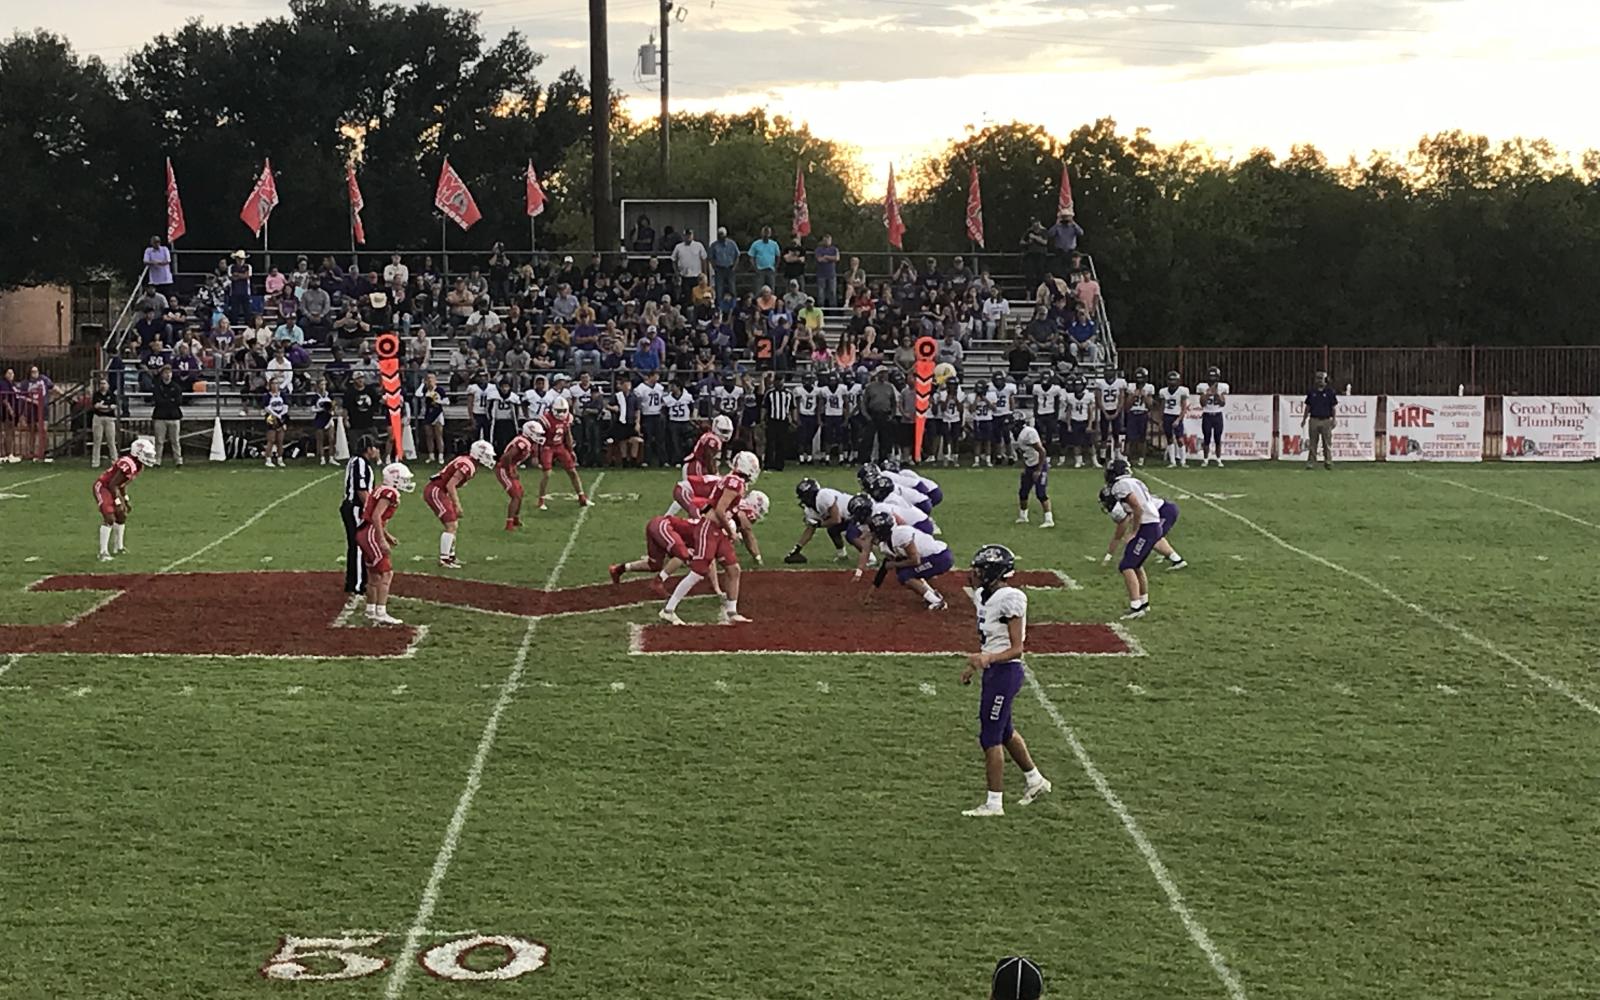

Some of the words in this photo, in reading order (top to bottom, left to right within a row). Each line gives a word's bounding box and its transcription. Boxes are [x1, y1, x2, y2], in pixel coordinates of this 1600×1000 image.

[757, 338, 772, 358] 2
[1103, 388, 1118, 403] 25
[671, 403, 686, 418] 55
[1393, 406, 1435, 428] HRC
[1550, 401, 1593, 415] Family
[1517, 415, 1585, 431] Plumbing
[1282, 435, 1301, 455] M
[1390, 435, 1409, 456] M
[1506, 436, 1525, 456] M
[260, 933, 549, 981] 50
